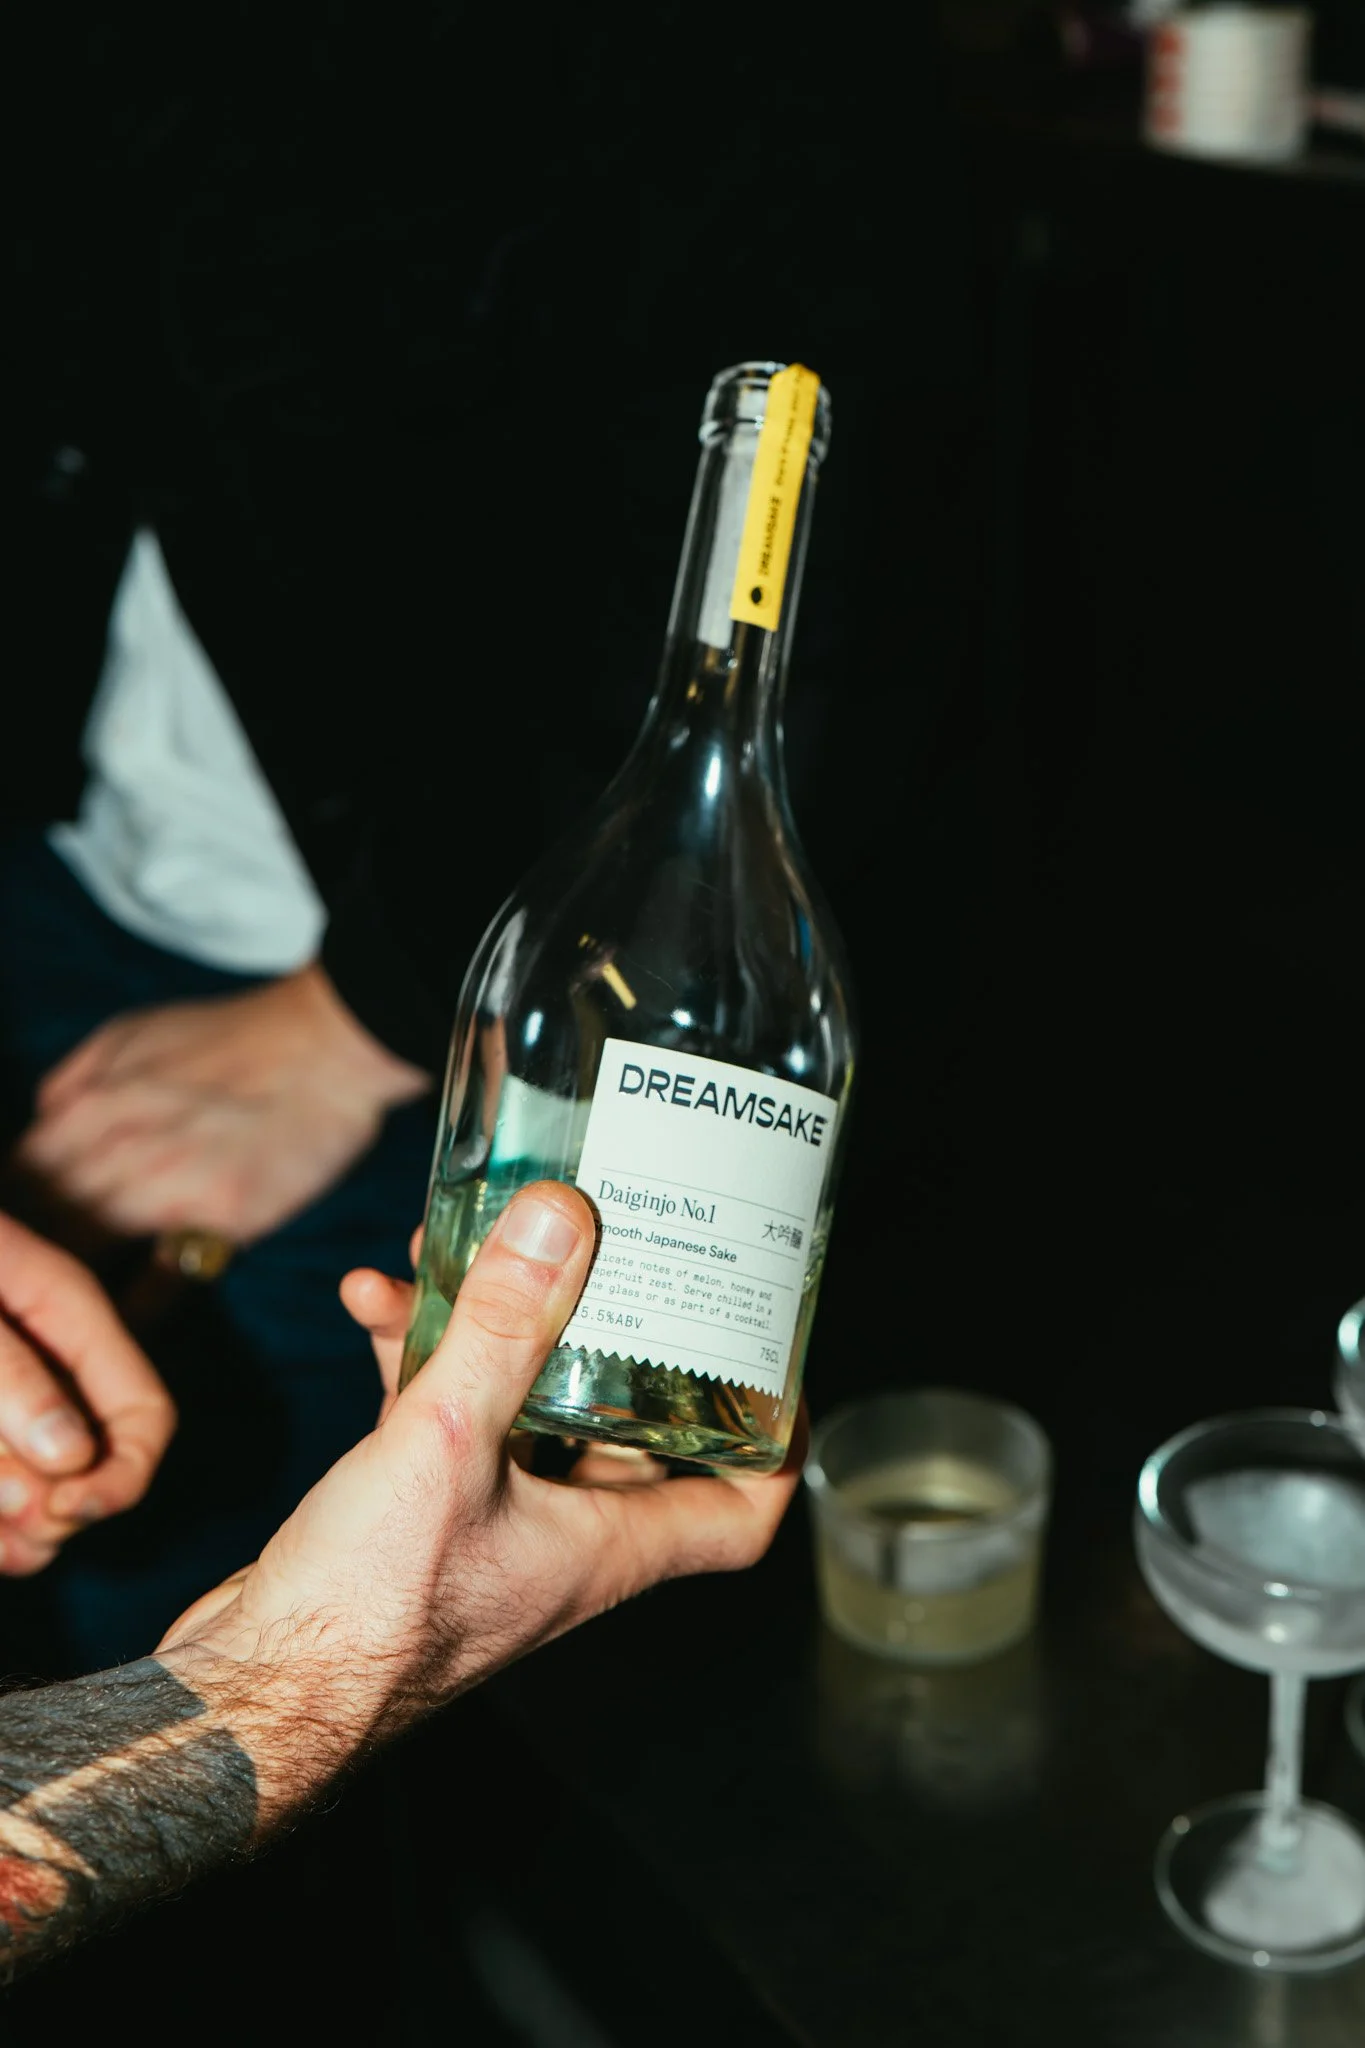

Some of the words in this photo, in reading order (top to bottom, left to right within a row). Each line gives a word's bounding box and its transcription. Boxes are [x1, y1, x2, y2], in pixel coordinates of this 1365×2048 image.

[618, 1063, 828, 1147] DREAMSAKE
[598, 1179, 676, 1217] Daiginjo
[680, 1197, 715, 1224] No.1
[645, 1231, 706, 1255] Japanese
[709, 1245, 737, 1263] Sake
[593, 1267, 643, 1284] apefruit
[648, 1278, 677, 1291] zest.
[684, 1284, 712, 1300] Serve
[717, 1294, 752, 1310] chilled
[640, 1261, 671, 1275] notes
[676, 1269, 688, 1278] of
[693, 1273, 725, 1289] melon,
[730, 1282, 755, 1297] honey
[574, 1305, 643, 1329] 5.5%ABV
[608, 1284, 640, 1298] glass
[645, 1292, 659, 1301] or
[663, 1297, 676, 1306] as
[680, 1300, 704, 1313] part
[709, 1306, 720, 1316] of
[725, 1311, 730, 1319] a
